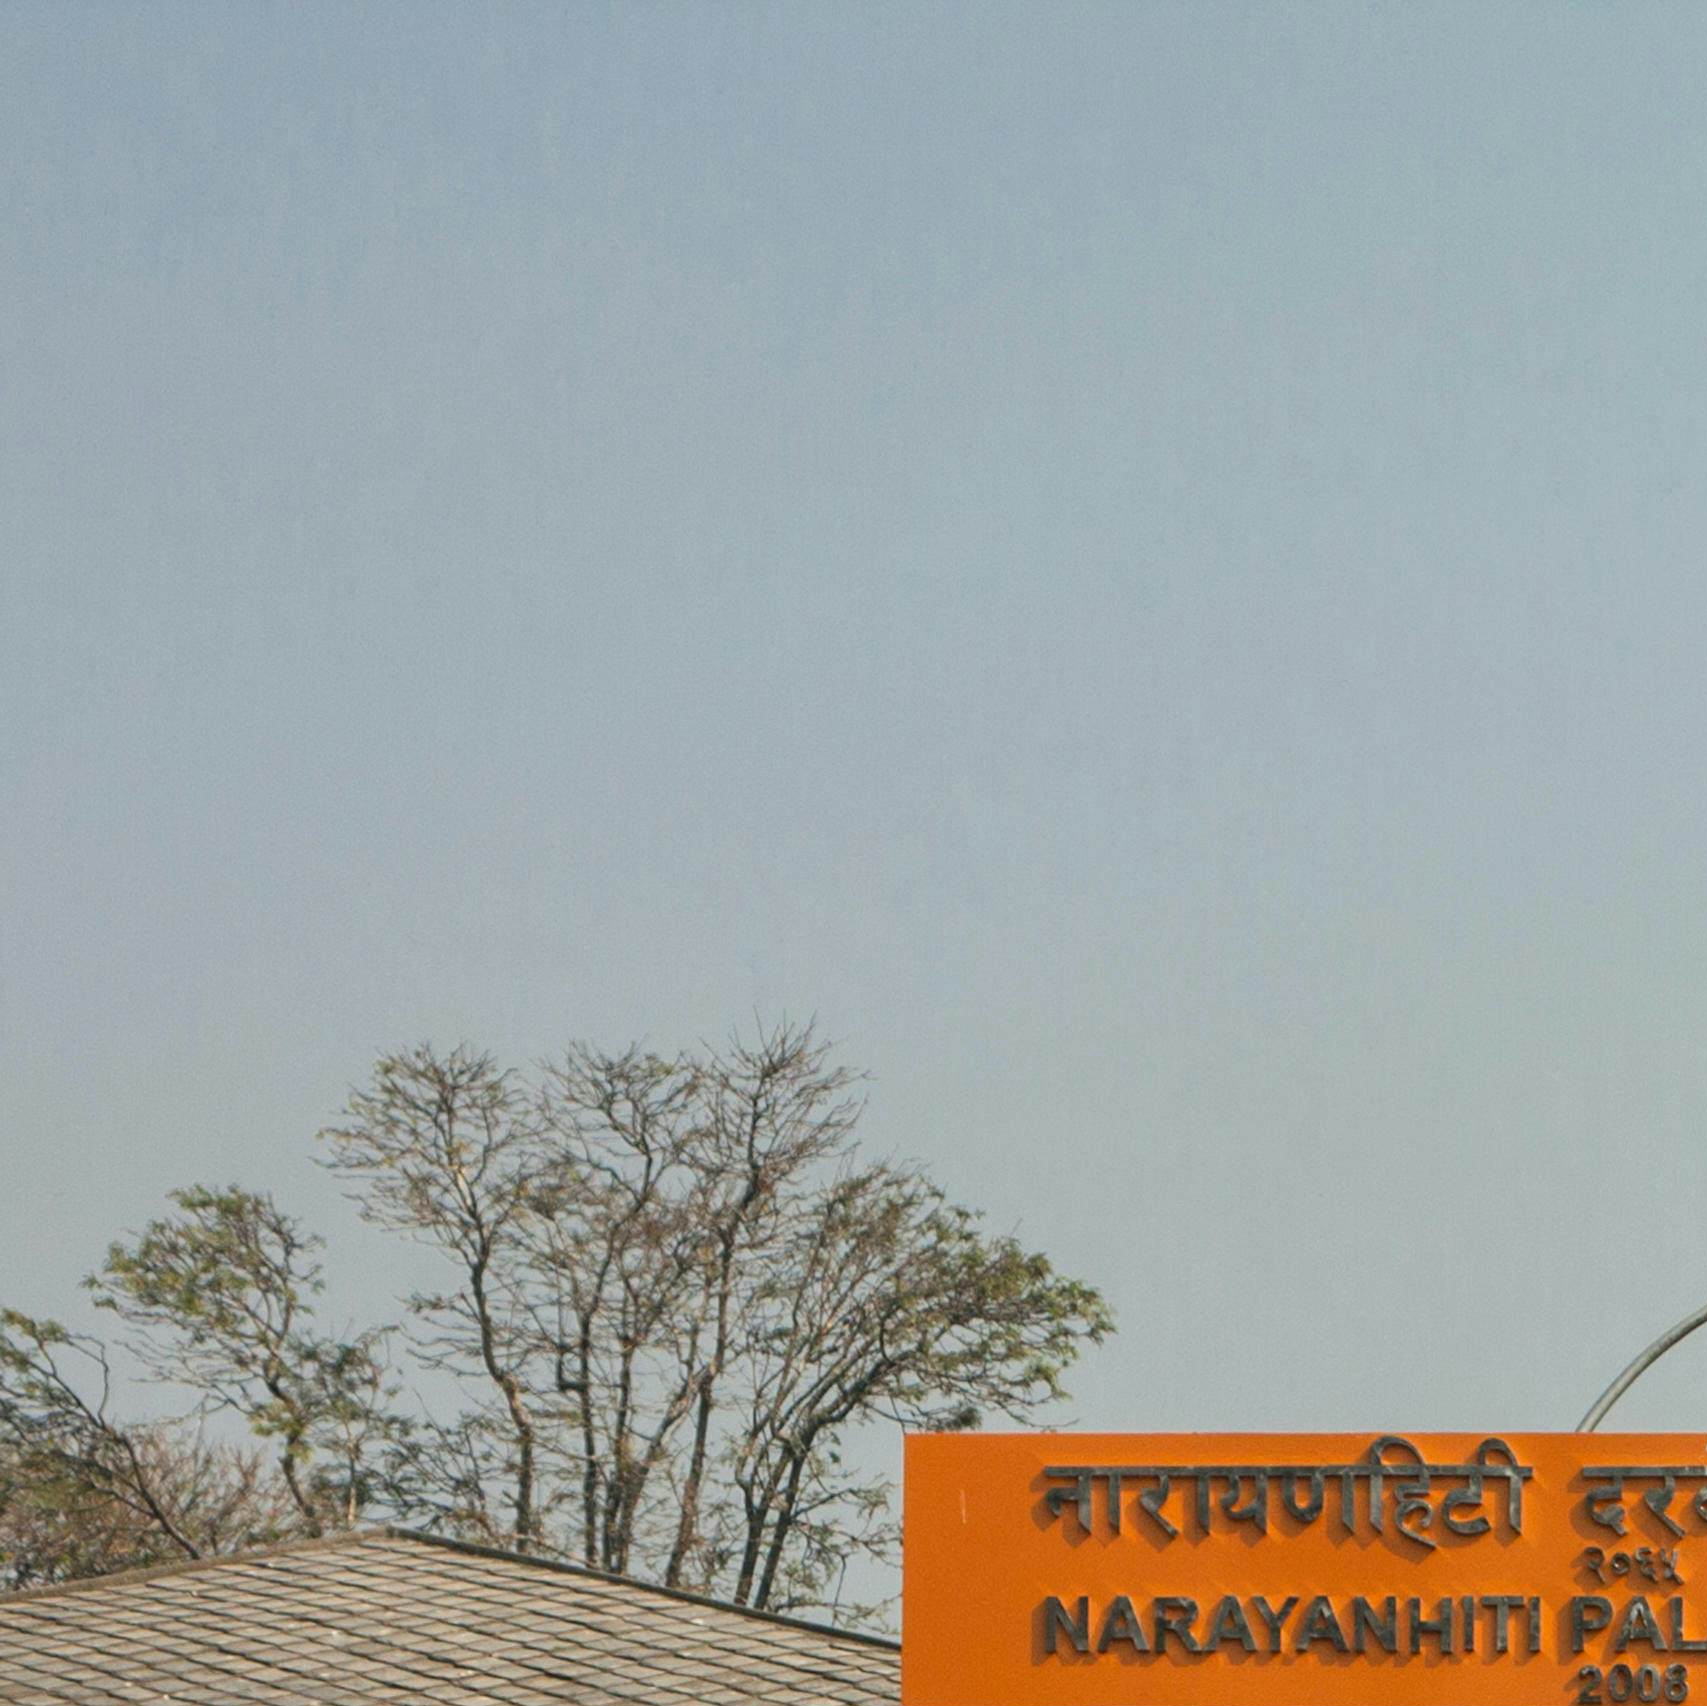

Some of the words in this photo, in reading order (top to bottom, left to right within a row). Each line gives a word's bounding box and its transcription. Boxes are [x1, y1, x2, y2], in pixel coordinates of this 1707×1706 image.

[1044, 1435, 1533, 1549] नारायणहिटी
[1583, 1546, 1685, 1585] २०६५
[1044, 1595, 1541, 1654] NARAYANHITI
[1577, 1663, 1689, 1705] 2008
